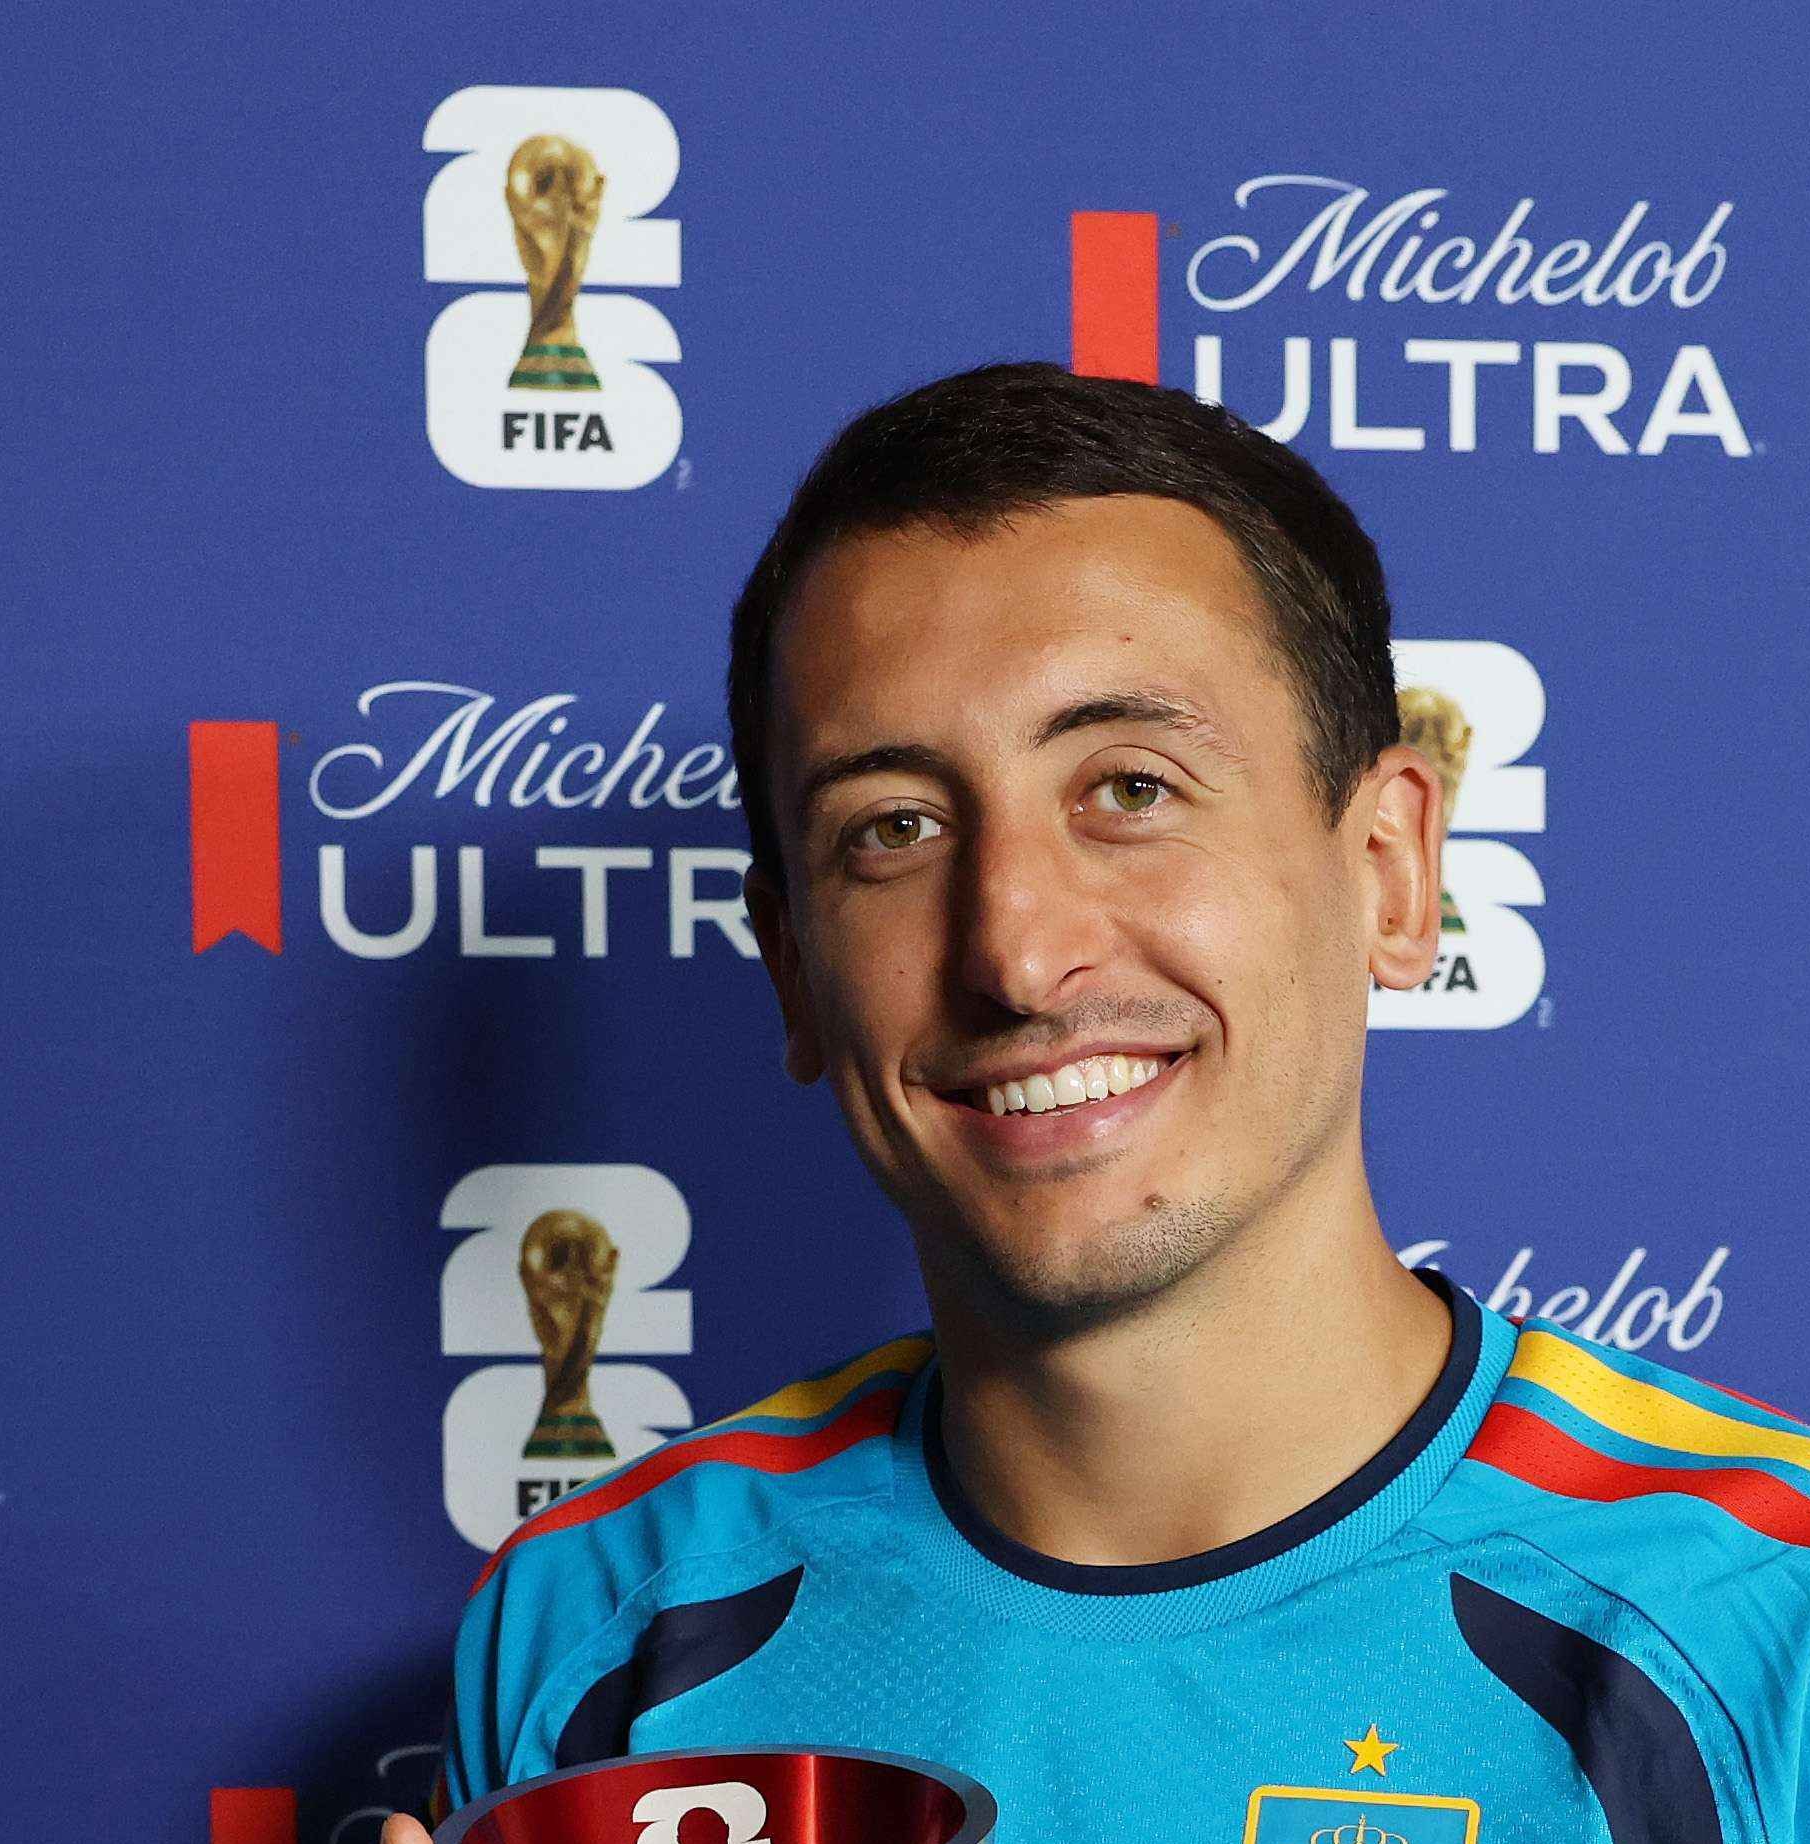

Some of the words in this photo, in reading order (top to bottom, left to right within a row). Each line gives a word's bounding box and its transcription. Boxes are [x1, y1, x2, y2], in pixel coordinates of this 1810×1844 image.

[1187, 175, 1733, 311] Michelob
[503, 412, 613, 451] FIFA
[1195, 335, 1752, 457] ULTRA
[310, 681, 740, 819] Miche
[318, 844, 761, 959] ULTR
[1397, 1238, 1731, 1352] helob
[518, 1480, 590, 1517] FI
